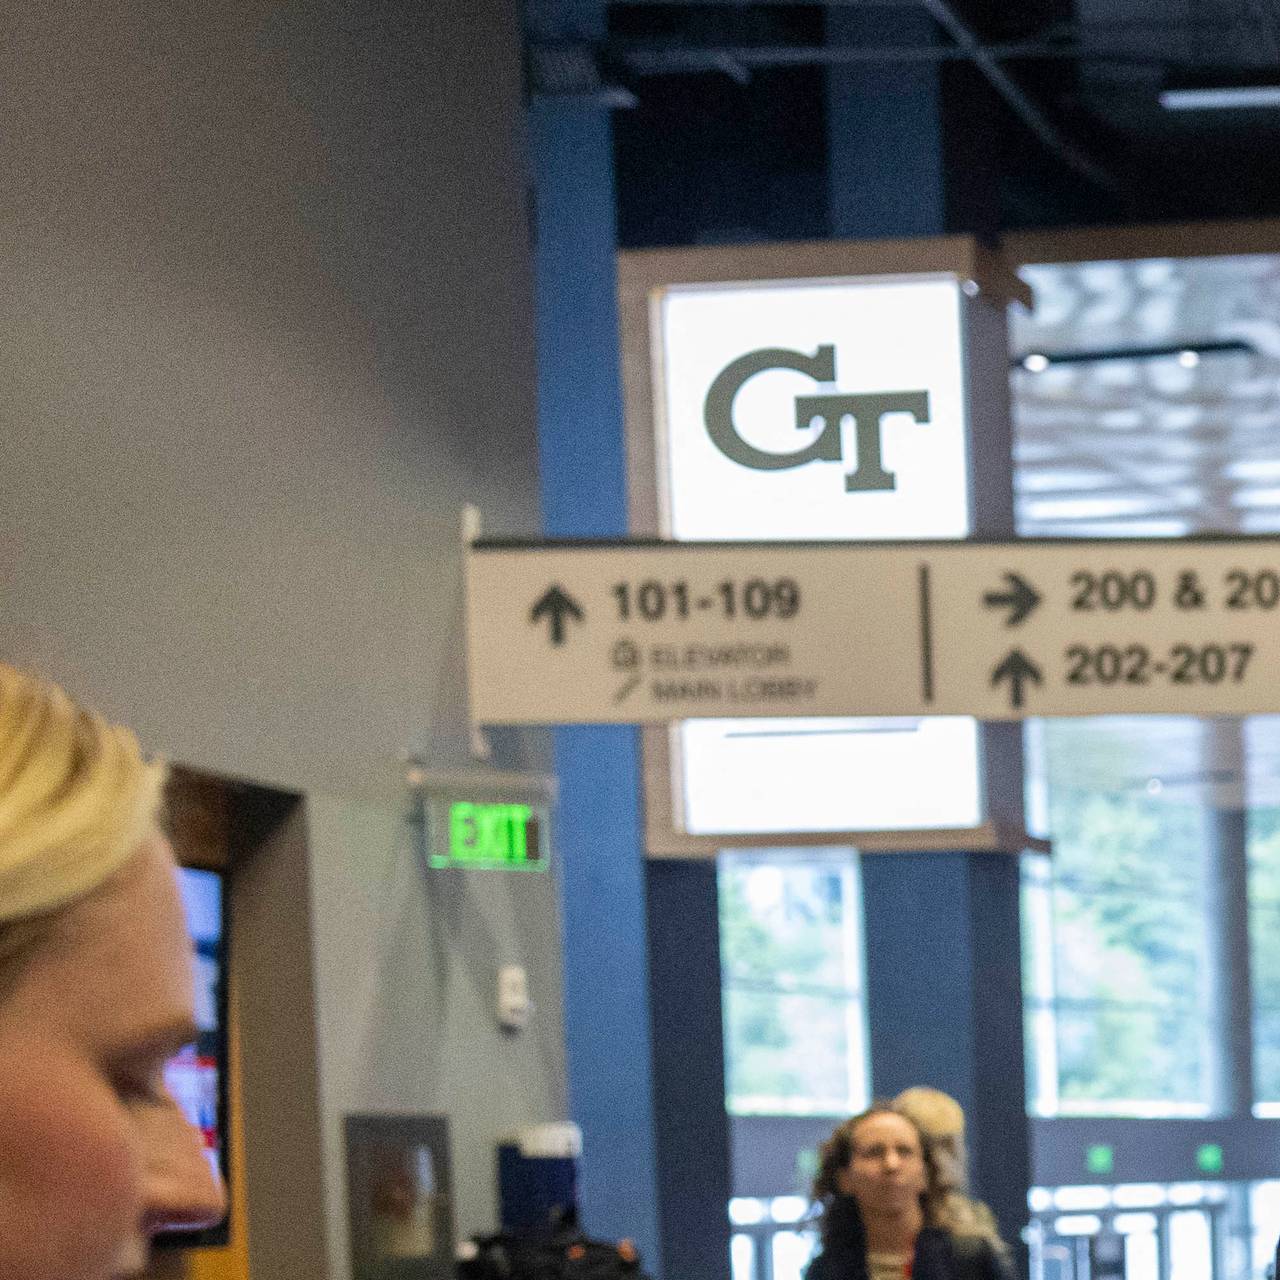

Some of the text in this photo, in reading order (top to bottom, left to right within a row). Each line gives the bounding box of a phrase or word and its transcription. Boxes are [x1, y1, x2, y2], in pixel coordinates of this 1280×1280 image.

[705, 345, 930, 492] GT
[613, 578, 800, 621] 101-109
[1071, 570, 1155, 610] 200
[1174, 571, 1206, 610] &
[652, 645, 788, 669] ELEVATOR
[1067, 643, 1255, 686] 202-207
[451, 802, 531, 862] EXIT
